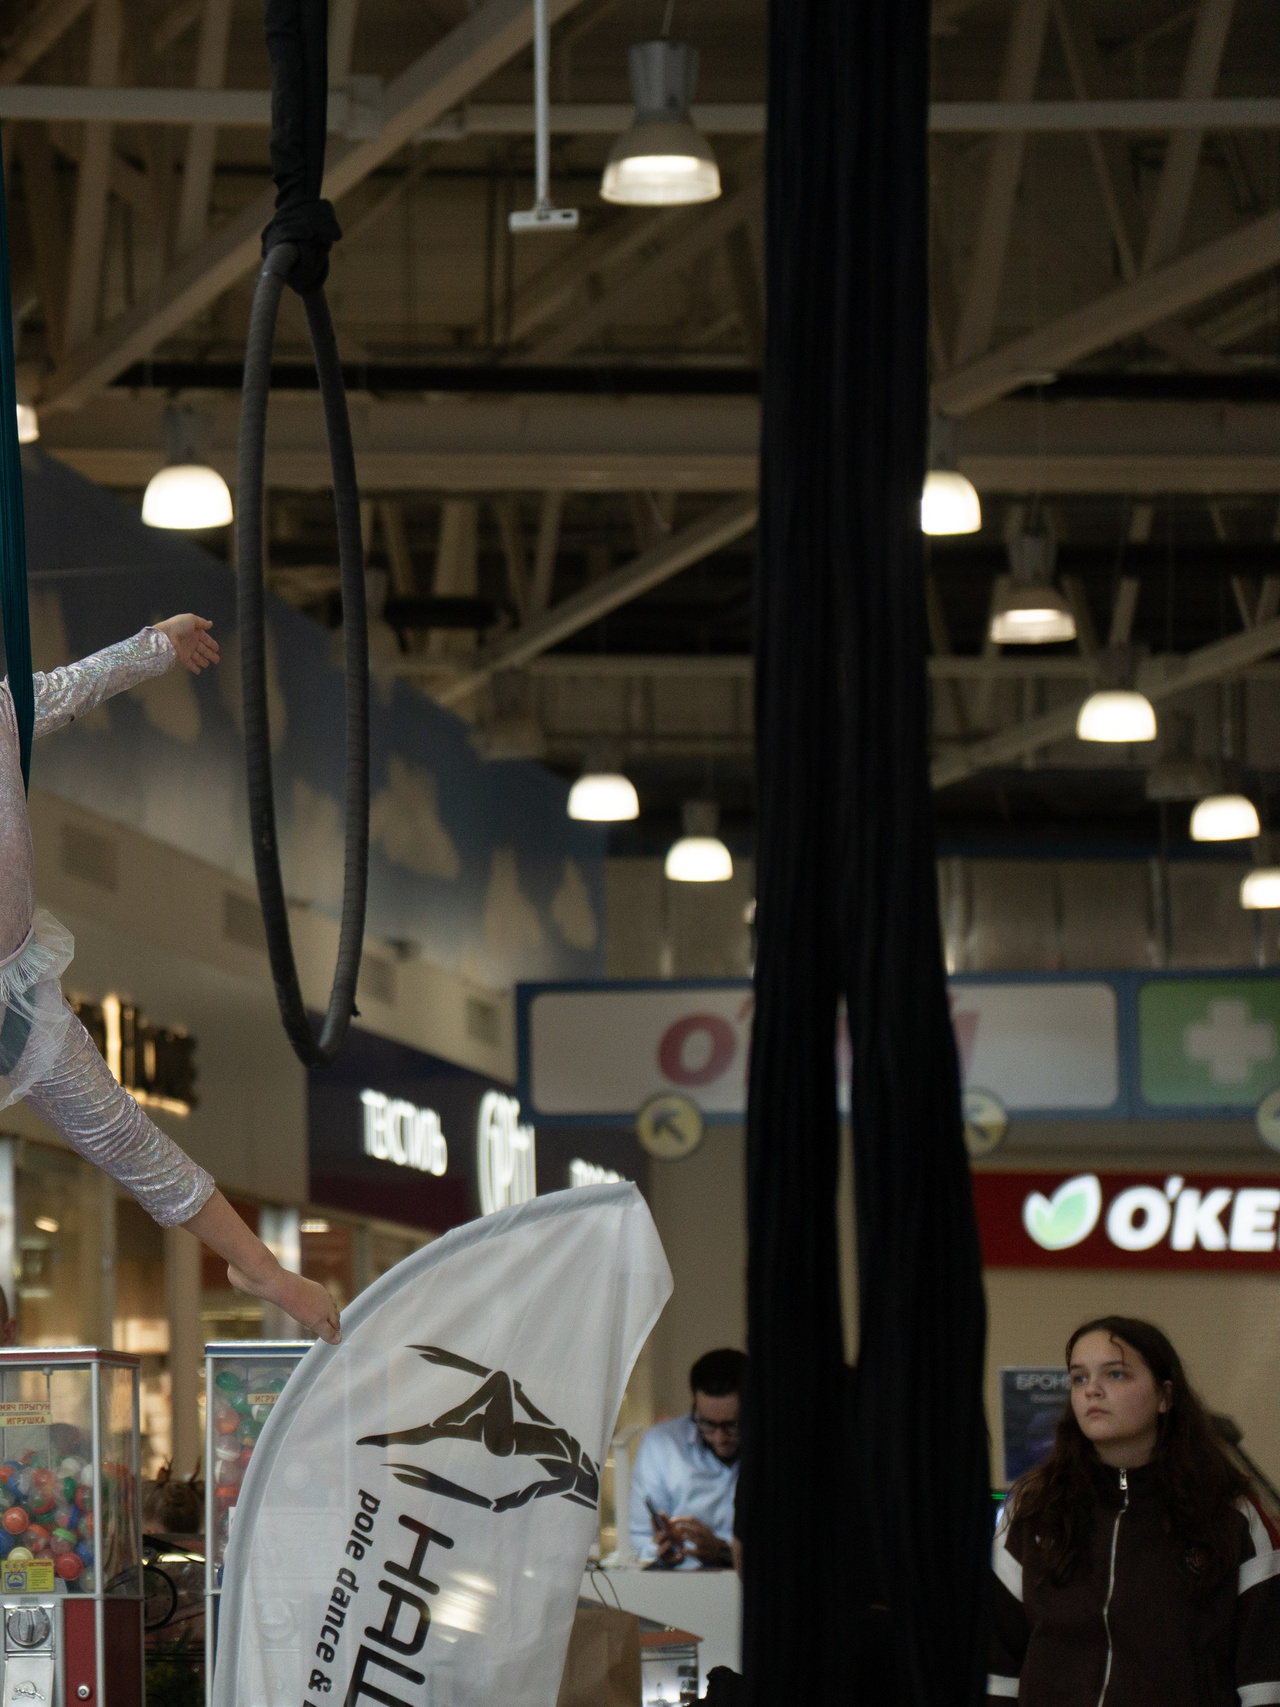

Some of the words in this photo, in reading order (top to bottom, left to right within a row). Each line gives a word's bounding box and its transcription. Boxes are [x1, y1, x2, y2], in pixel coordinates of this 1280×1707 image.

[1105, 1174, 1280, 1252] О'КЕ
[19, 1403, 50, 1411] ПРЫГУН
[254, 1395, 280, 1403] ИГРУ
[6, 1416, 46, 1425] ИГРУШКА
[345, 1489, 381, 1561] pole
[315, 1567, 359, 1663] dance
[308, 1669, 332, 1692] &
